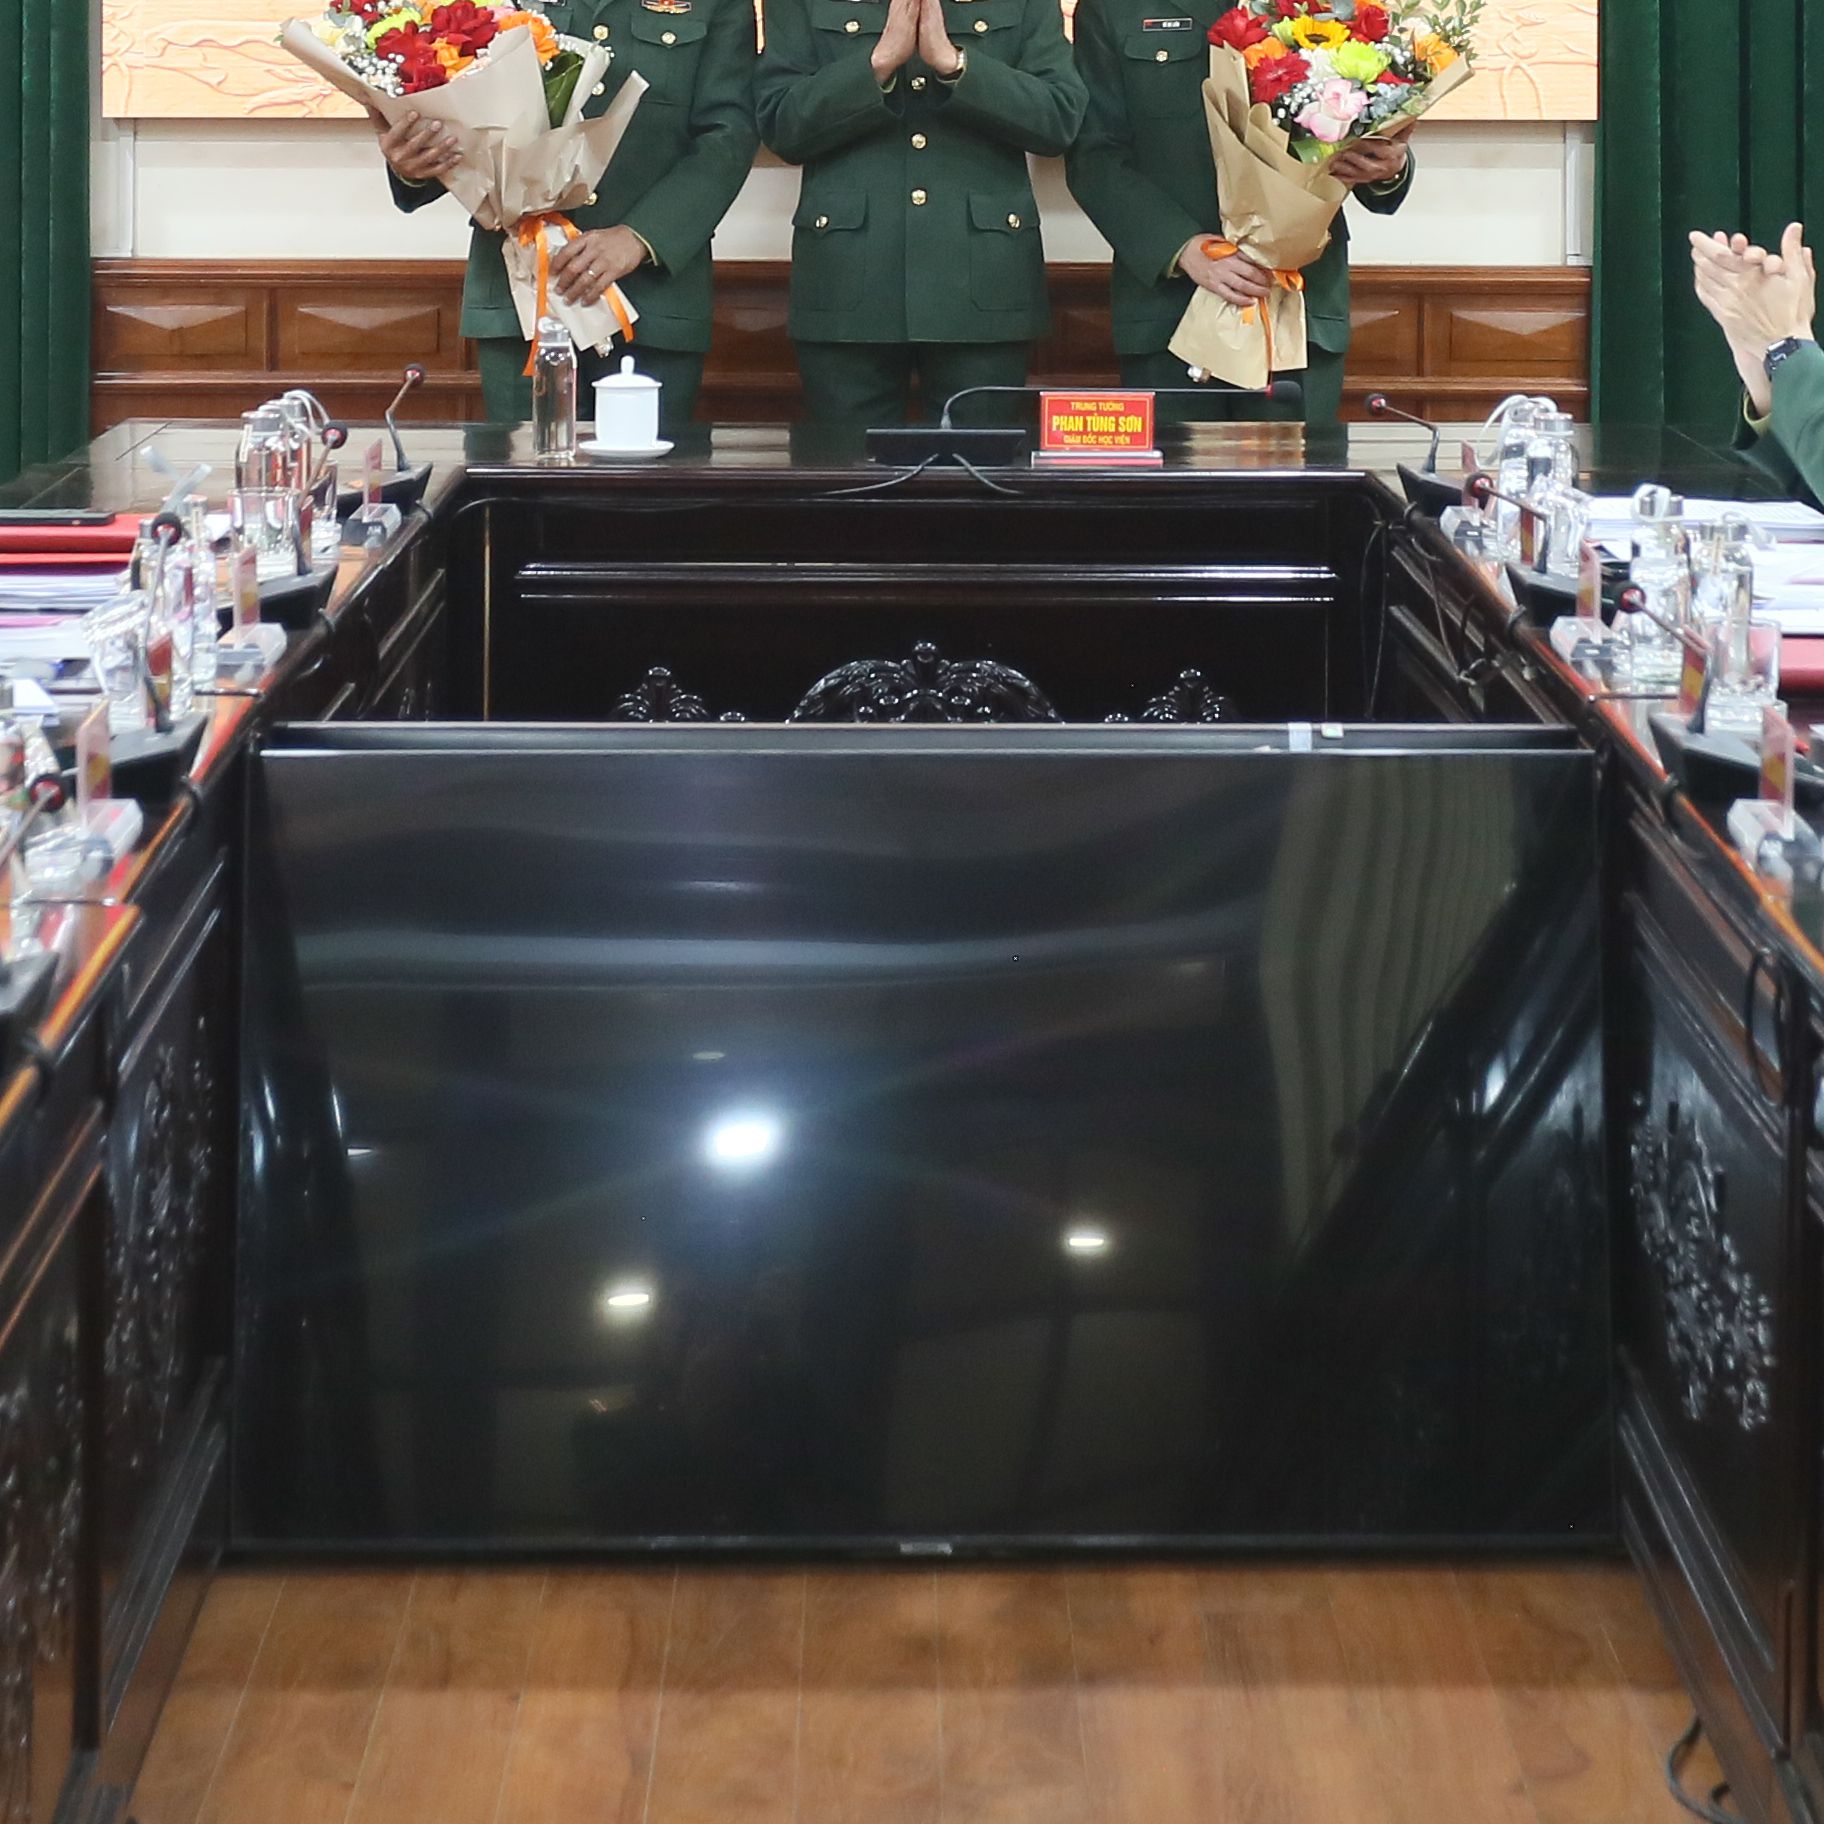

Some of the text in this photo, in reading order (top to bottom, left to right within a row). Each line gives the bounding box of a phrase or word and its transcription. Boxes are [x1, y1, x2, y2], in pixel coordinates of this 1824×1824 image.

[1070, 401, 1098, 412] TRUNG
[1051, 412, 1144, 433] PHAN TÙNG SƠN
